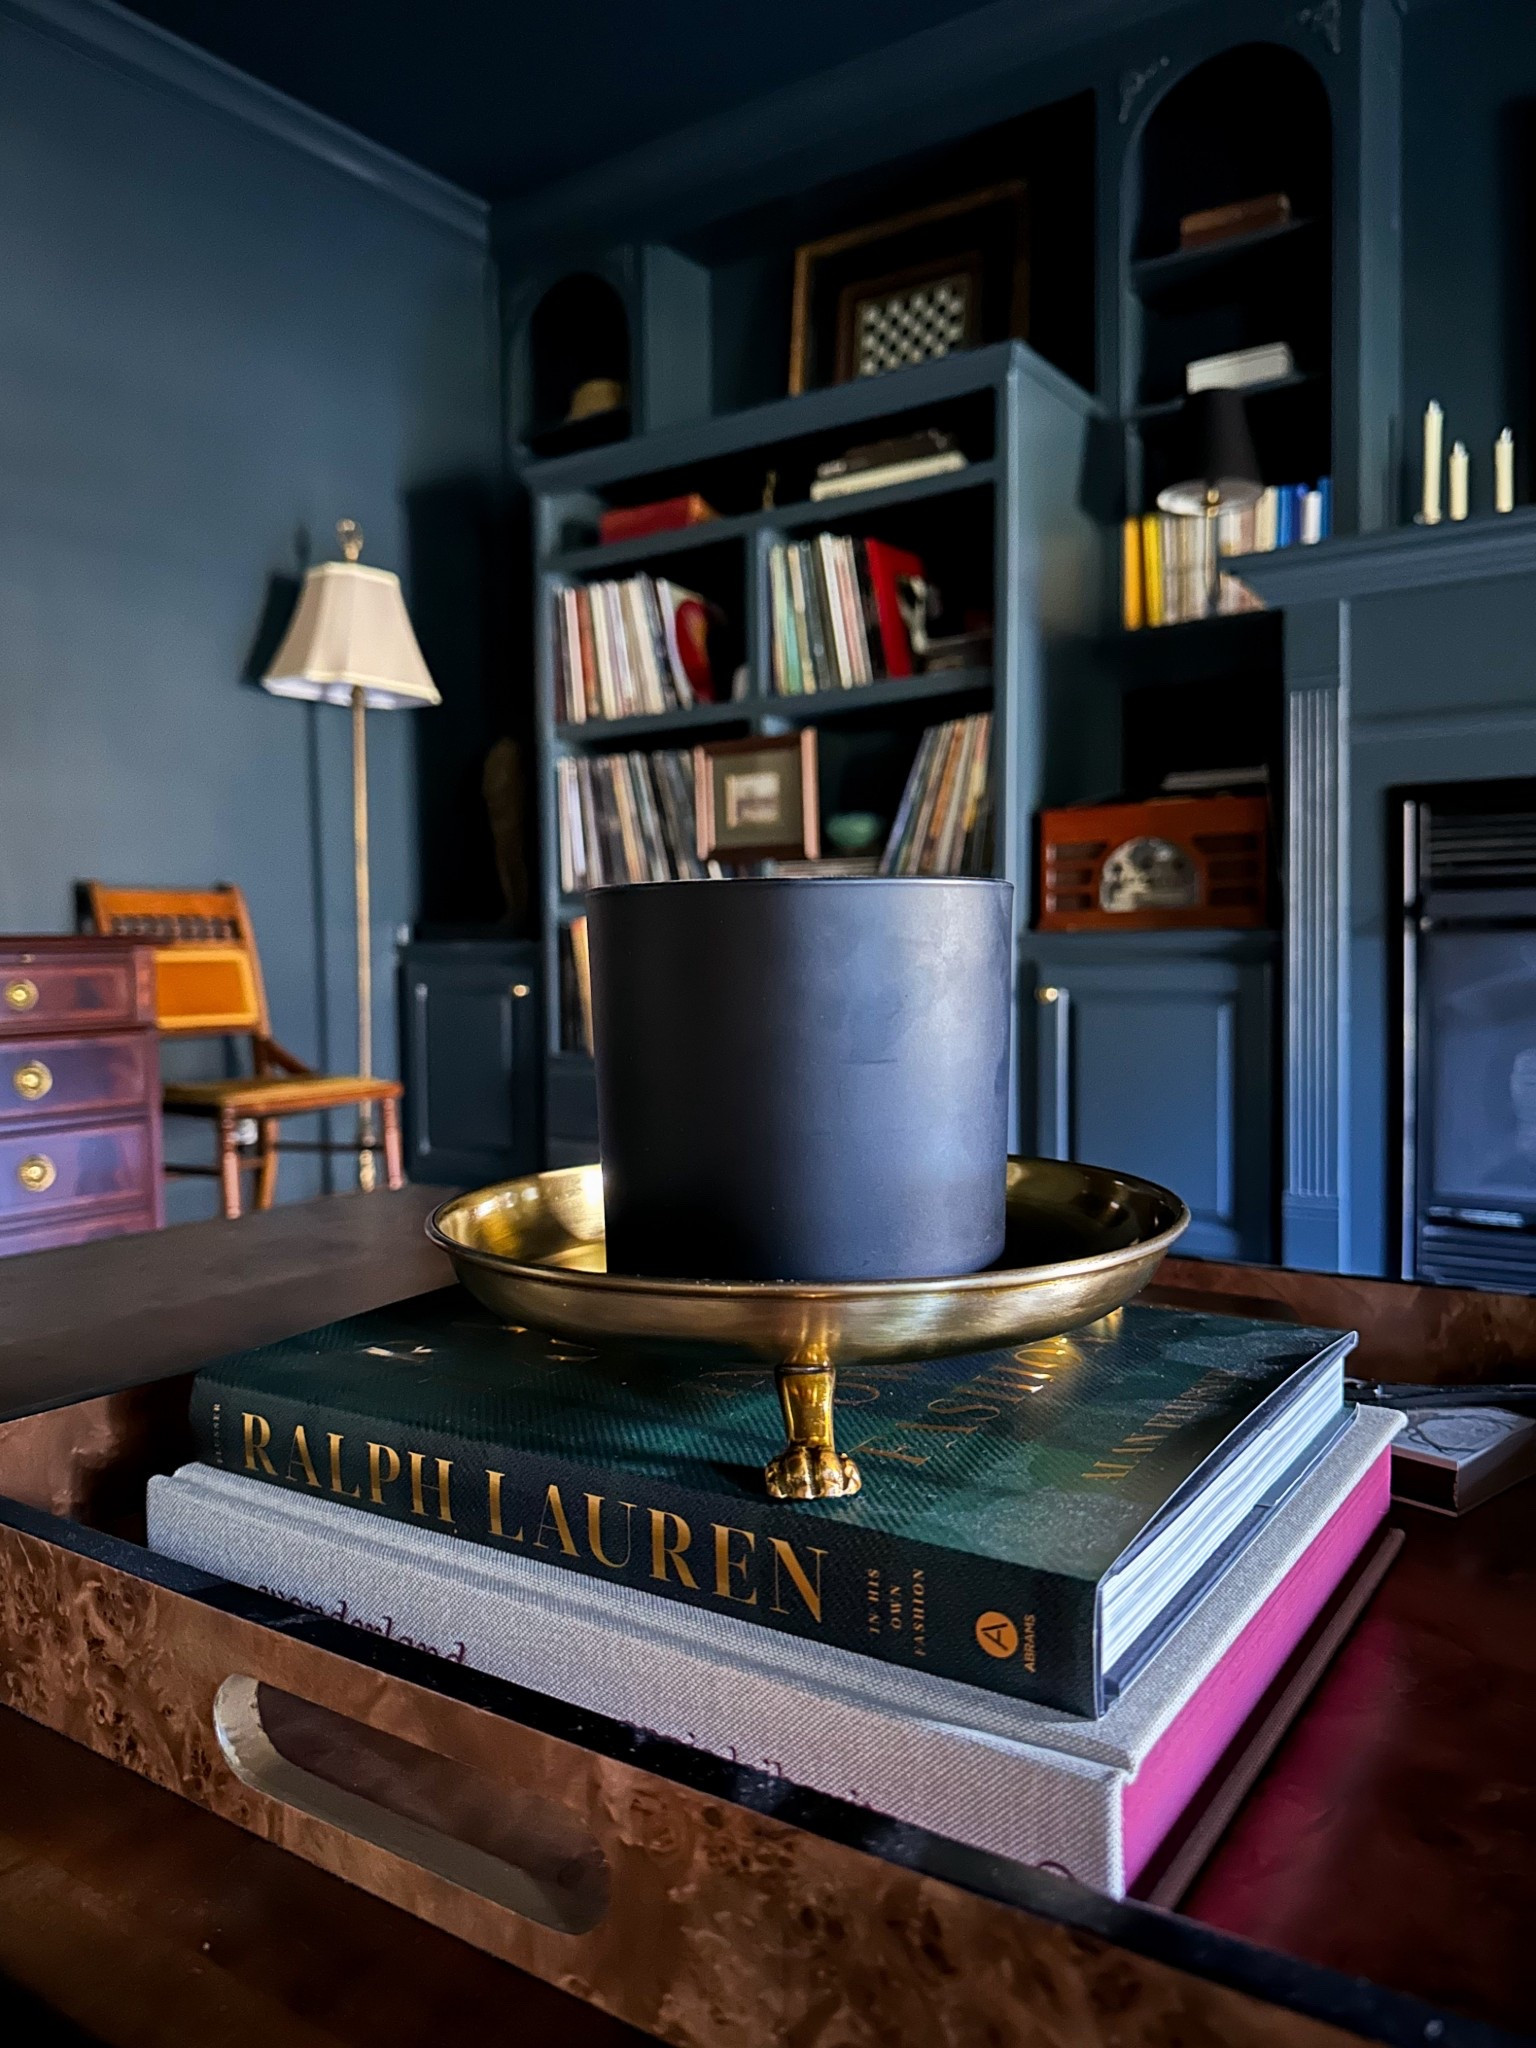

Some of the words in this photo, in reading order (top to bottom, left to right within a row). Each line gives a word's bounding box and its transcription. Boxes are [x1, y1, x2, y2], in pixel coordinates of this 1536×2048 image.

[241, 1411, 456, 1524] RALPH
[485, 1470, 829, 1624] LAUREN
[867, 1568, 881, 1605] HIS
[889, 1584, 902, 1630] OWN
[912, 1568, 927, 1657] FASHION
[868, 1611, 881, 1635] IN
[1023, 1613, 1038, 1674] ABRAMS
